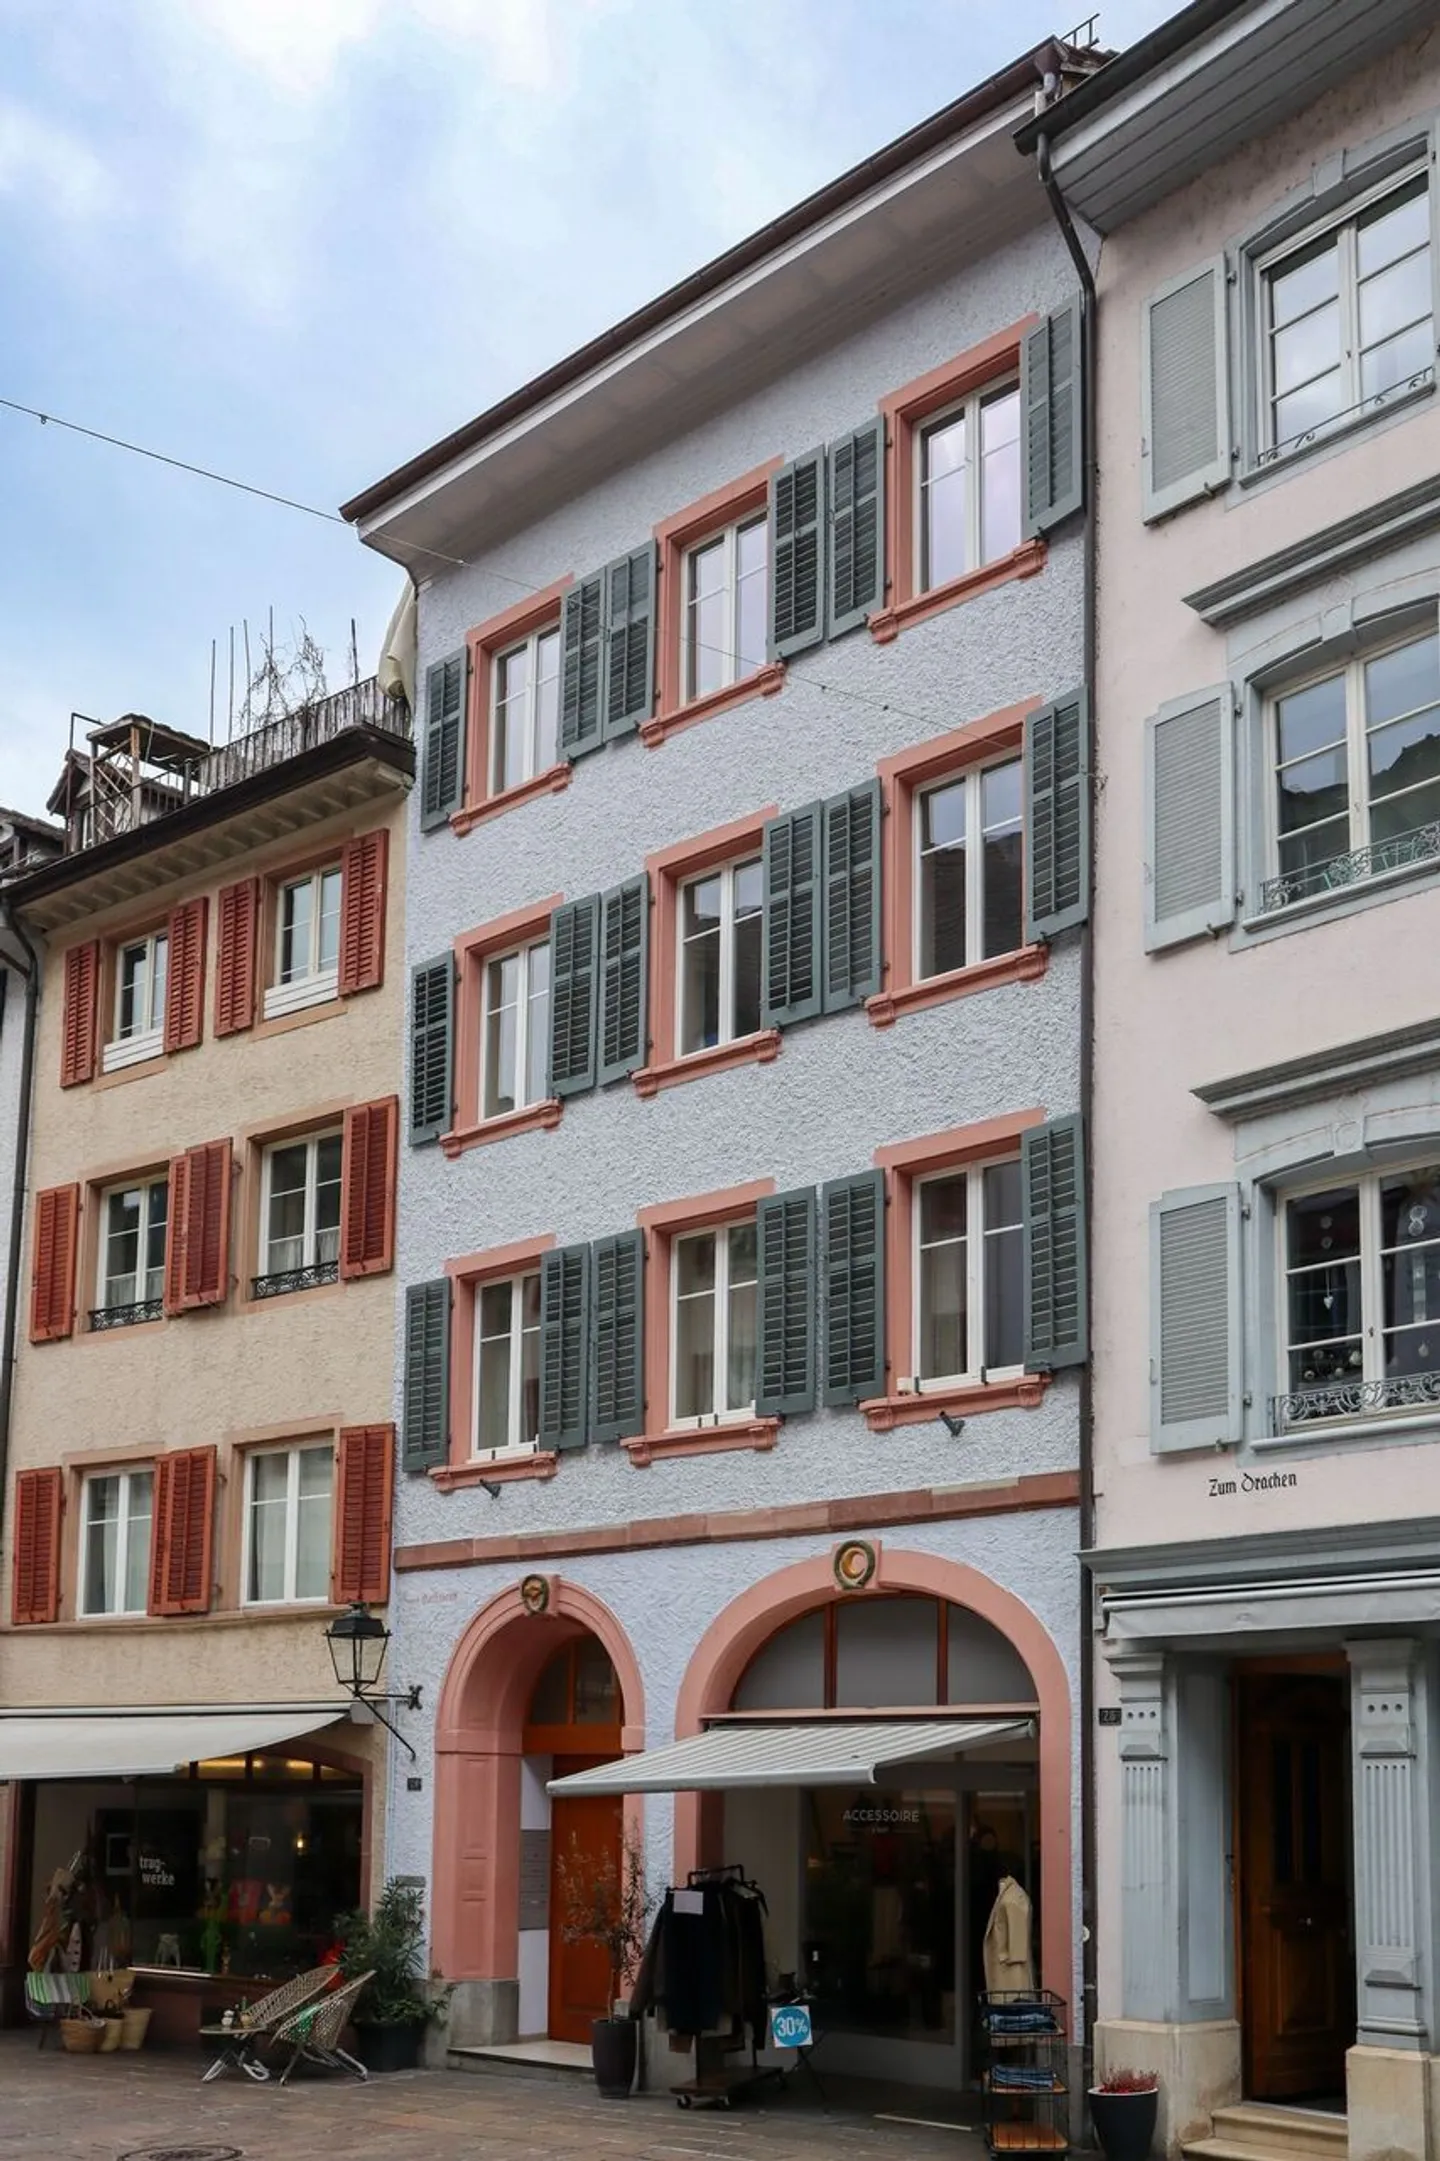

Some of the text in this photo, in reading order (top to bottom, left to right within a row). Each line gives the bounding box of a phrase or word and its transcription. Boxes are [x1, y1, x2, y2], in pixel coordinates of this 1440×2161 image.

[1208, 1472, 1298, 1497] Zum Drachen
[842, 1809, 920, 1823] ACCESSOIRE
[142, 1869, 175, 1886] werke
[776, 2016, 808, 2037] 30%
